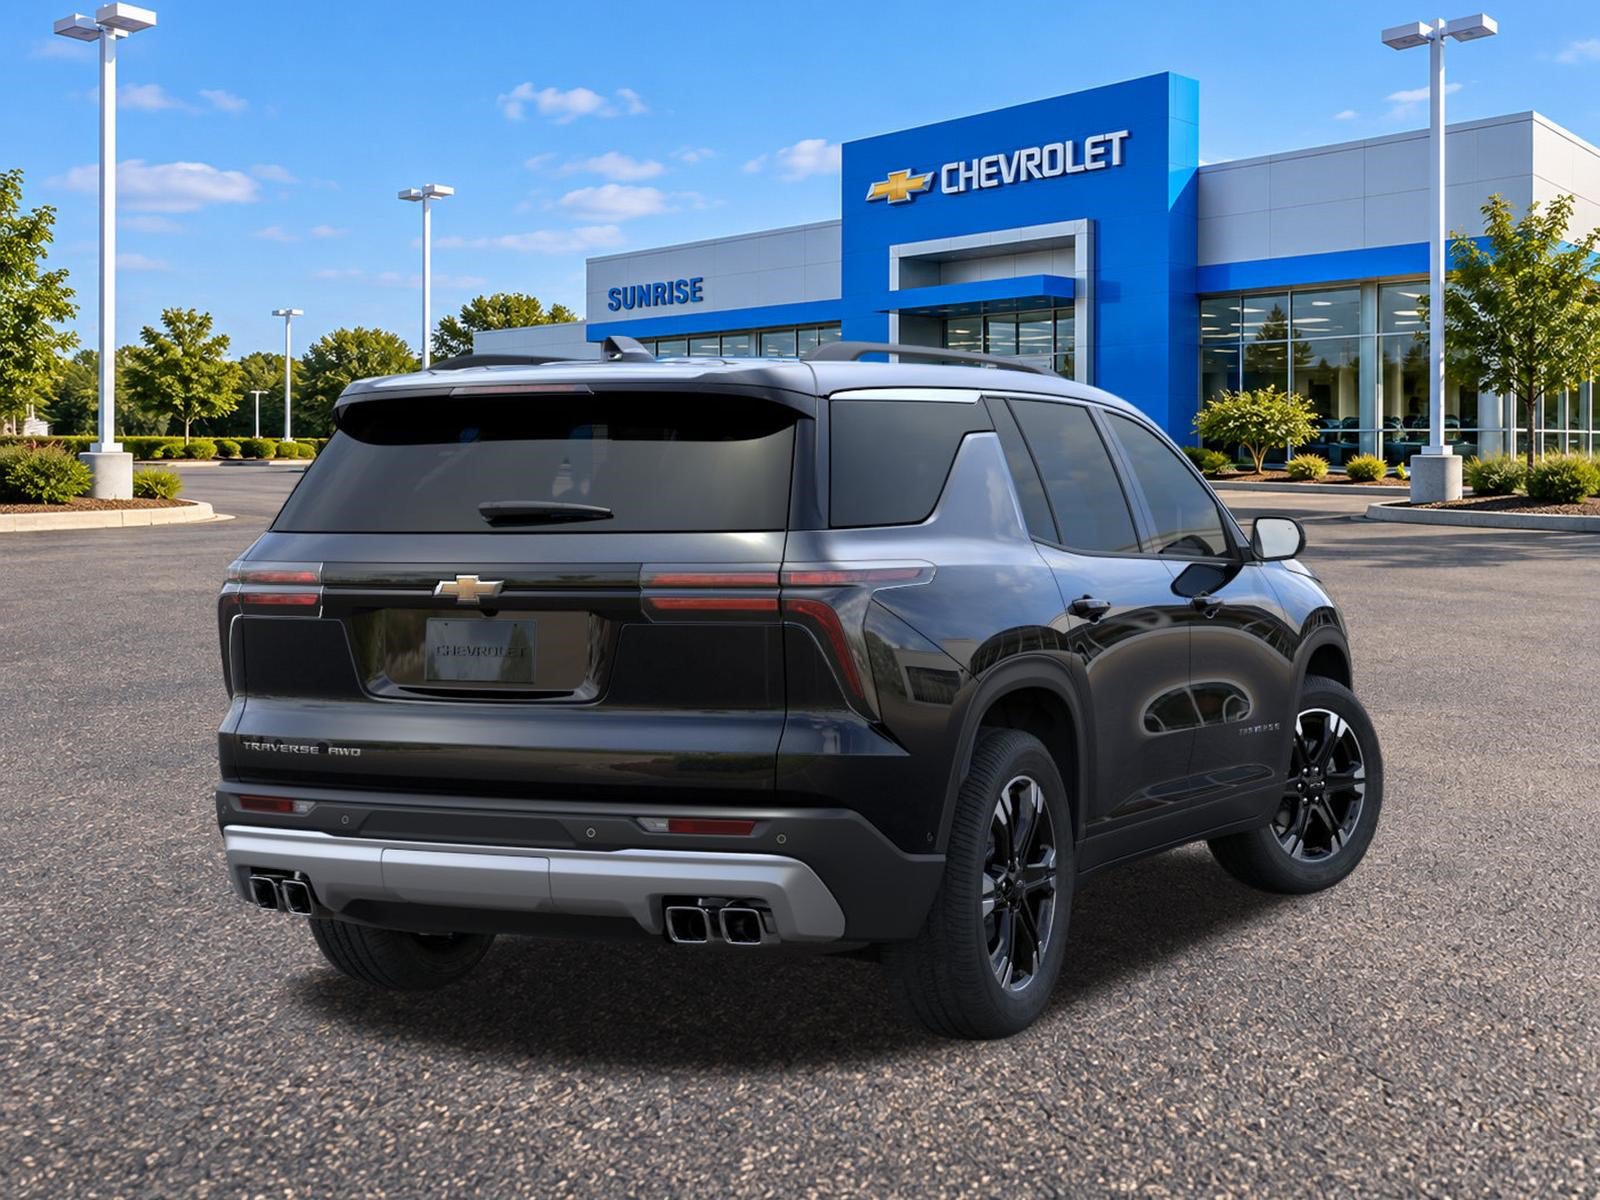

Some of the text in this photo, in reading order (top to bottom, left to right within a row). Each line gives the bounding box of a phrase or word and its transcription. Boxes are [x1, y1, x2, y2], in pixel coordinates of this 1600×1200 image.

[941, 130, 1128, 194] CHEVROLET
[608, 277, 703, 312] SUNRISE
[436, 645, 527, 657] CHEVROLET
[243, 741, 361, 756] TRAVERSE AWD
